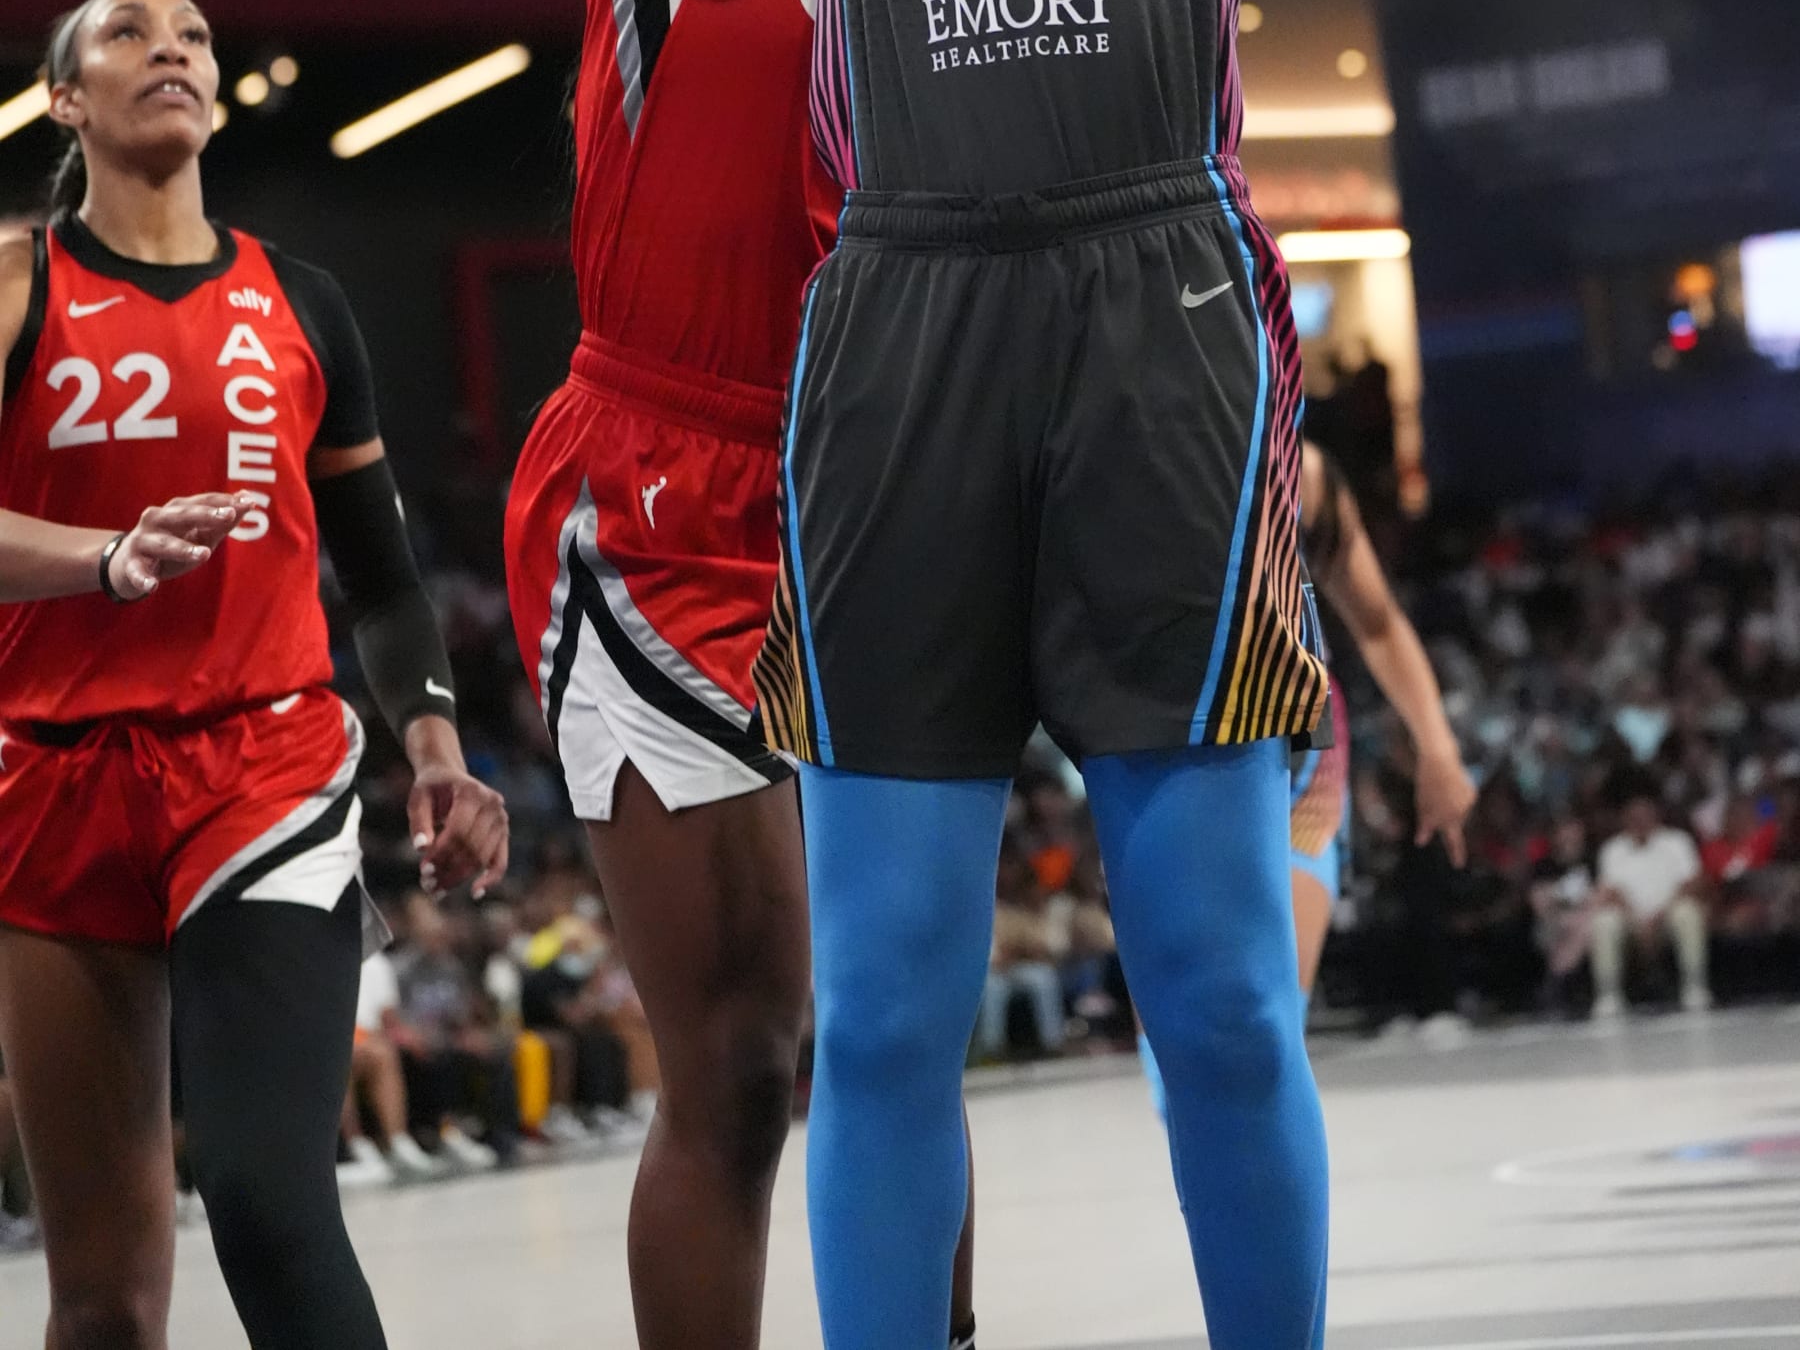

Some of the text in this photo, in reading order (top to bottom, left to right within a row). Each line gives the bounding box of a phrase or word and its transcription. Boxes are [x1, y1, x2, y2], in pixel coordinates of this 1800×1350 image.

[931, 33, 1111, 73] HEALTHCARE
[228, 287, 272, 318] ally
[46, 352, 178, 450] 22
[216, 323, 278, 542] ACES
